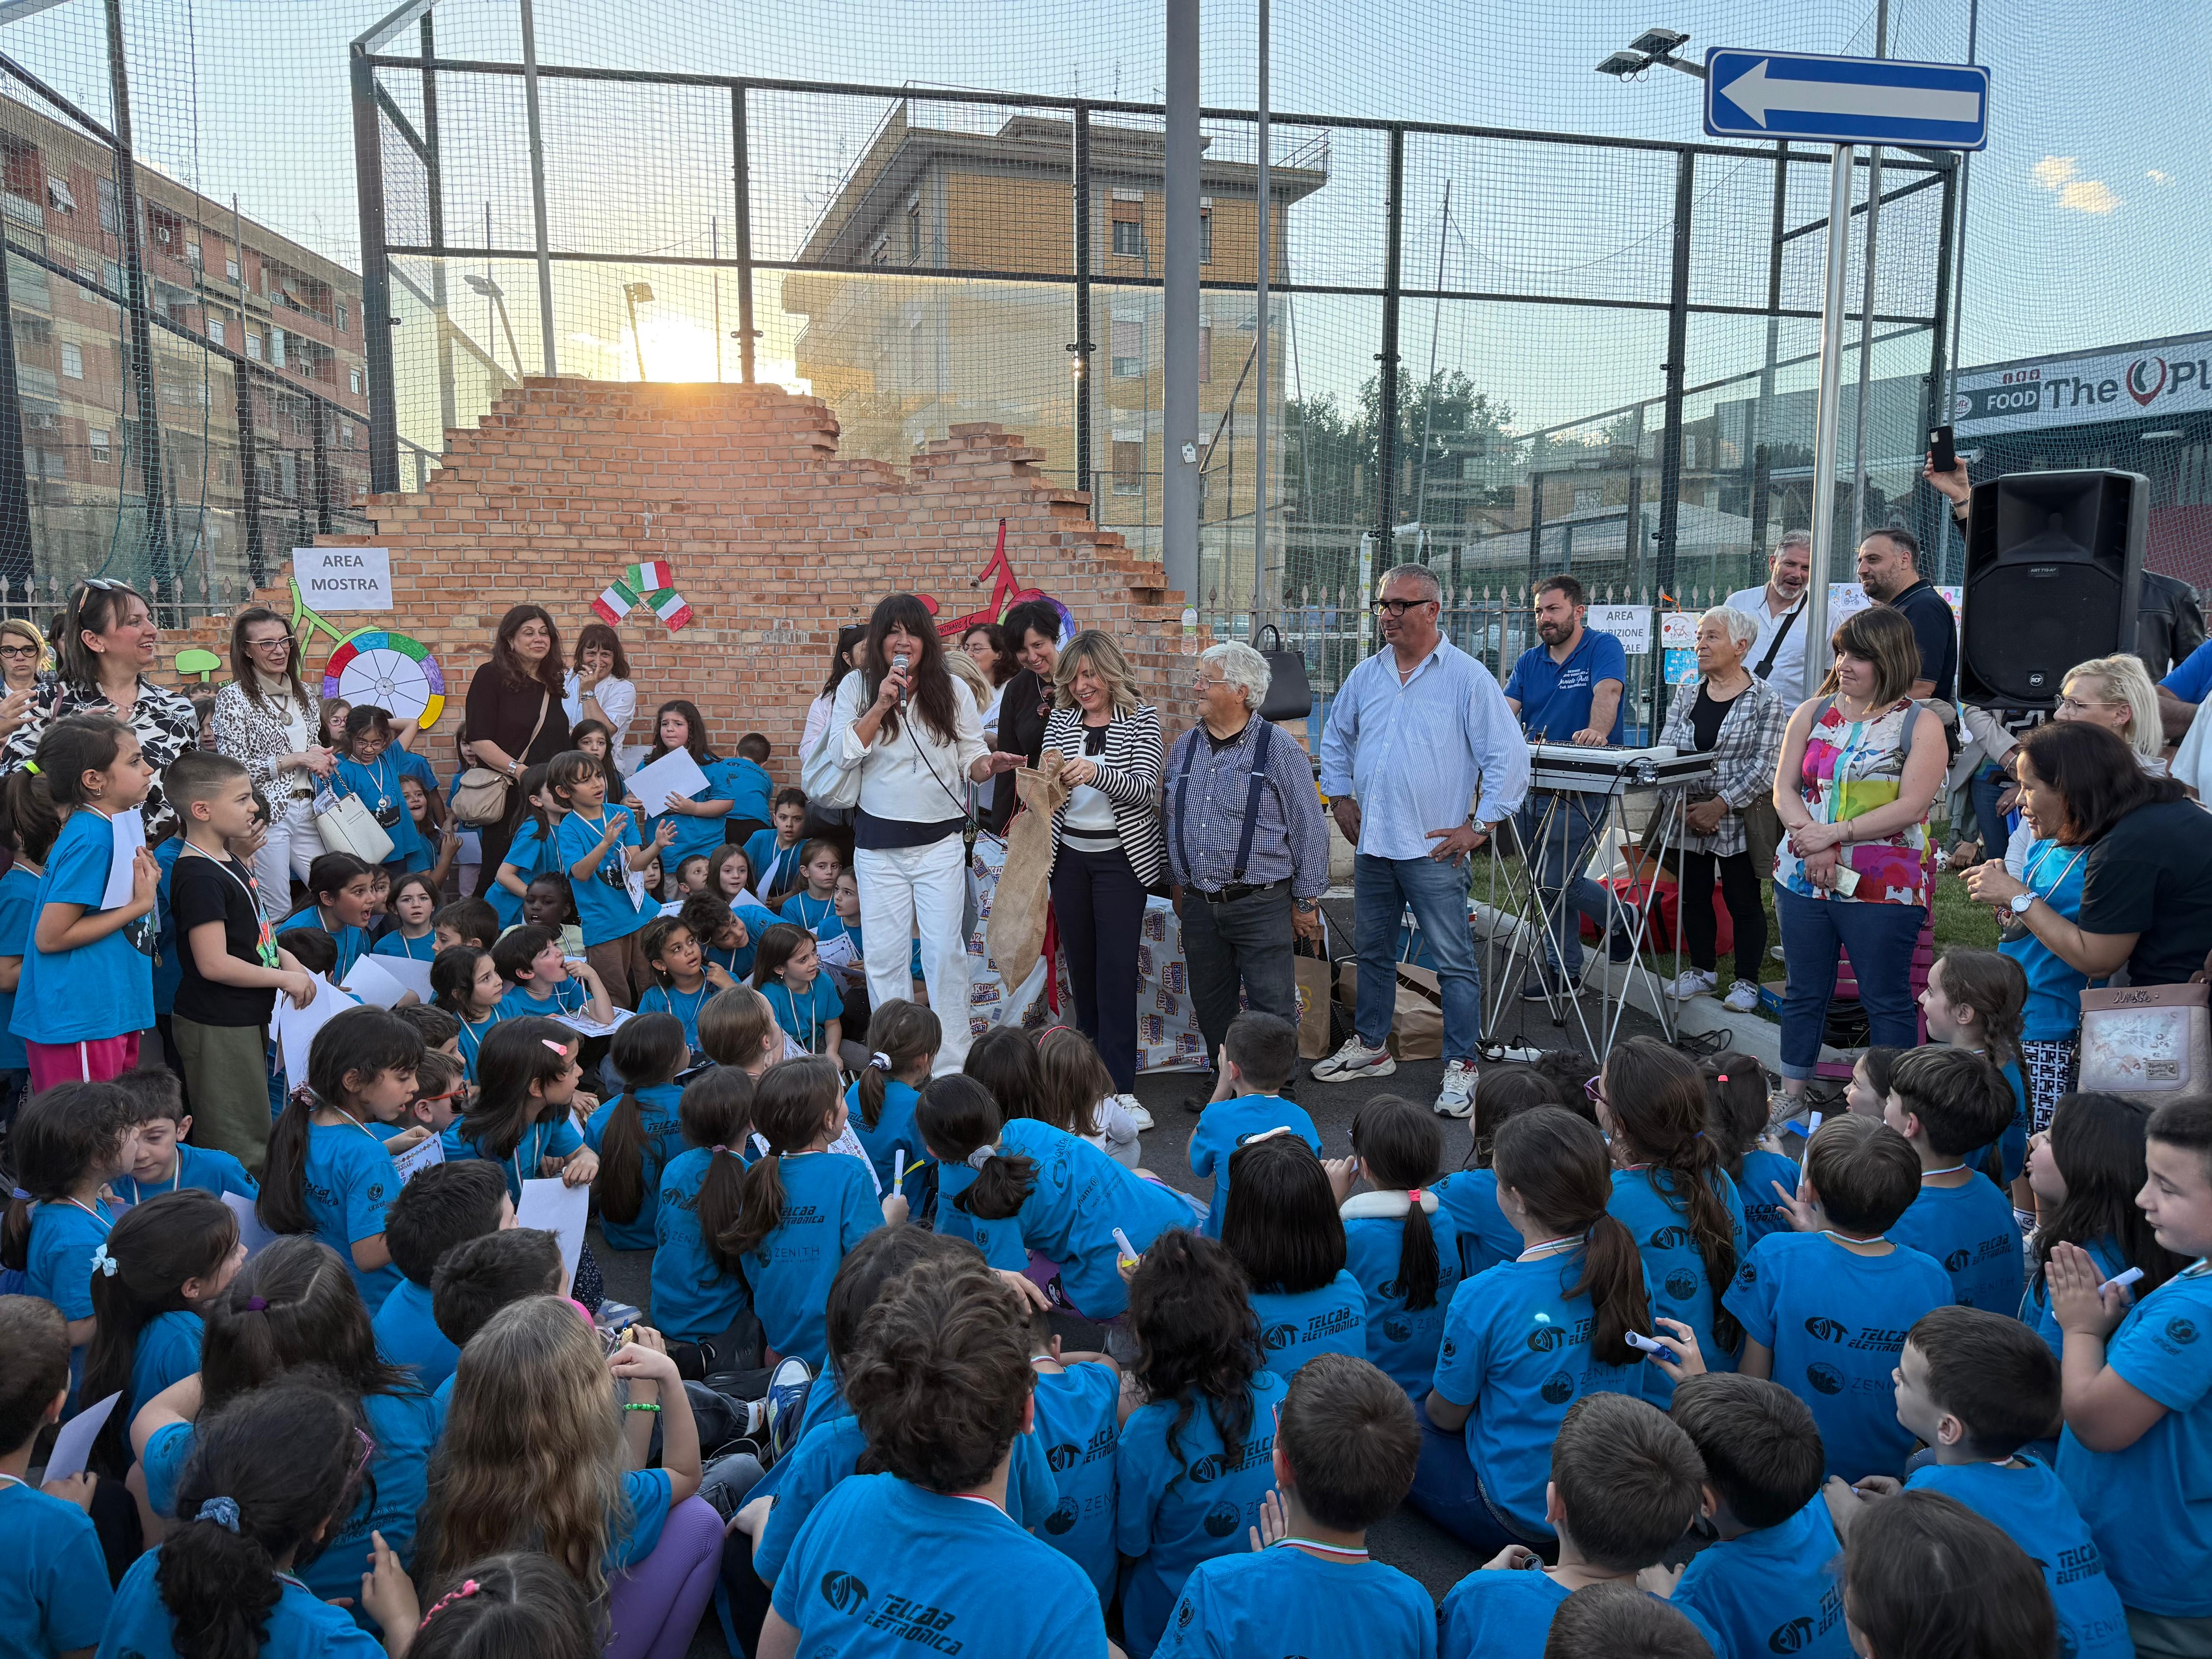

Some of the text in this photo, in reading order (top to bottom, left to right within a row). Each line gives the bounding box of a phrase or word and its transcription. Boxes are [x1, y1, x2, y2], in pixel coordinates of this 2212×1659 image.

[1987, 390, 2037, 410] FOOD
[2044, 377, 2118, 409] The
[323, 555, 364, 567] AREA
[311, 578, 379, 591] MOSTRA
[1606, 611, 1633, 621] AREA
[781, 1206, 817, 1217] ELCAB
[671, 1231, 696, 1244] ZENI
[775, 1246, 820, 1257] ZENITH
[1308, 1306, 1351, 1331] TELCAB
[1302, 1316, 1360, 1343] ELETTRONICA
[1852, 1377, 1891, 1391] ZENI
[333, 1529, 365, 1546] ENTRO
[879, 1593, 956, 1631] TELCAB
[863, 1610, 963, 1656] ELETTRONICA
